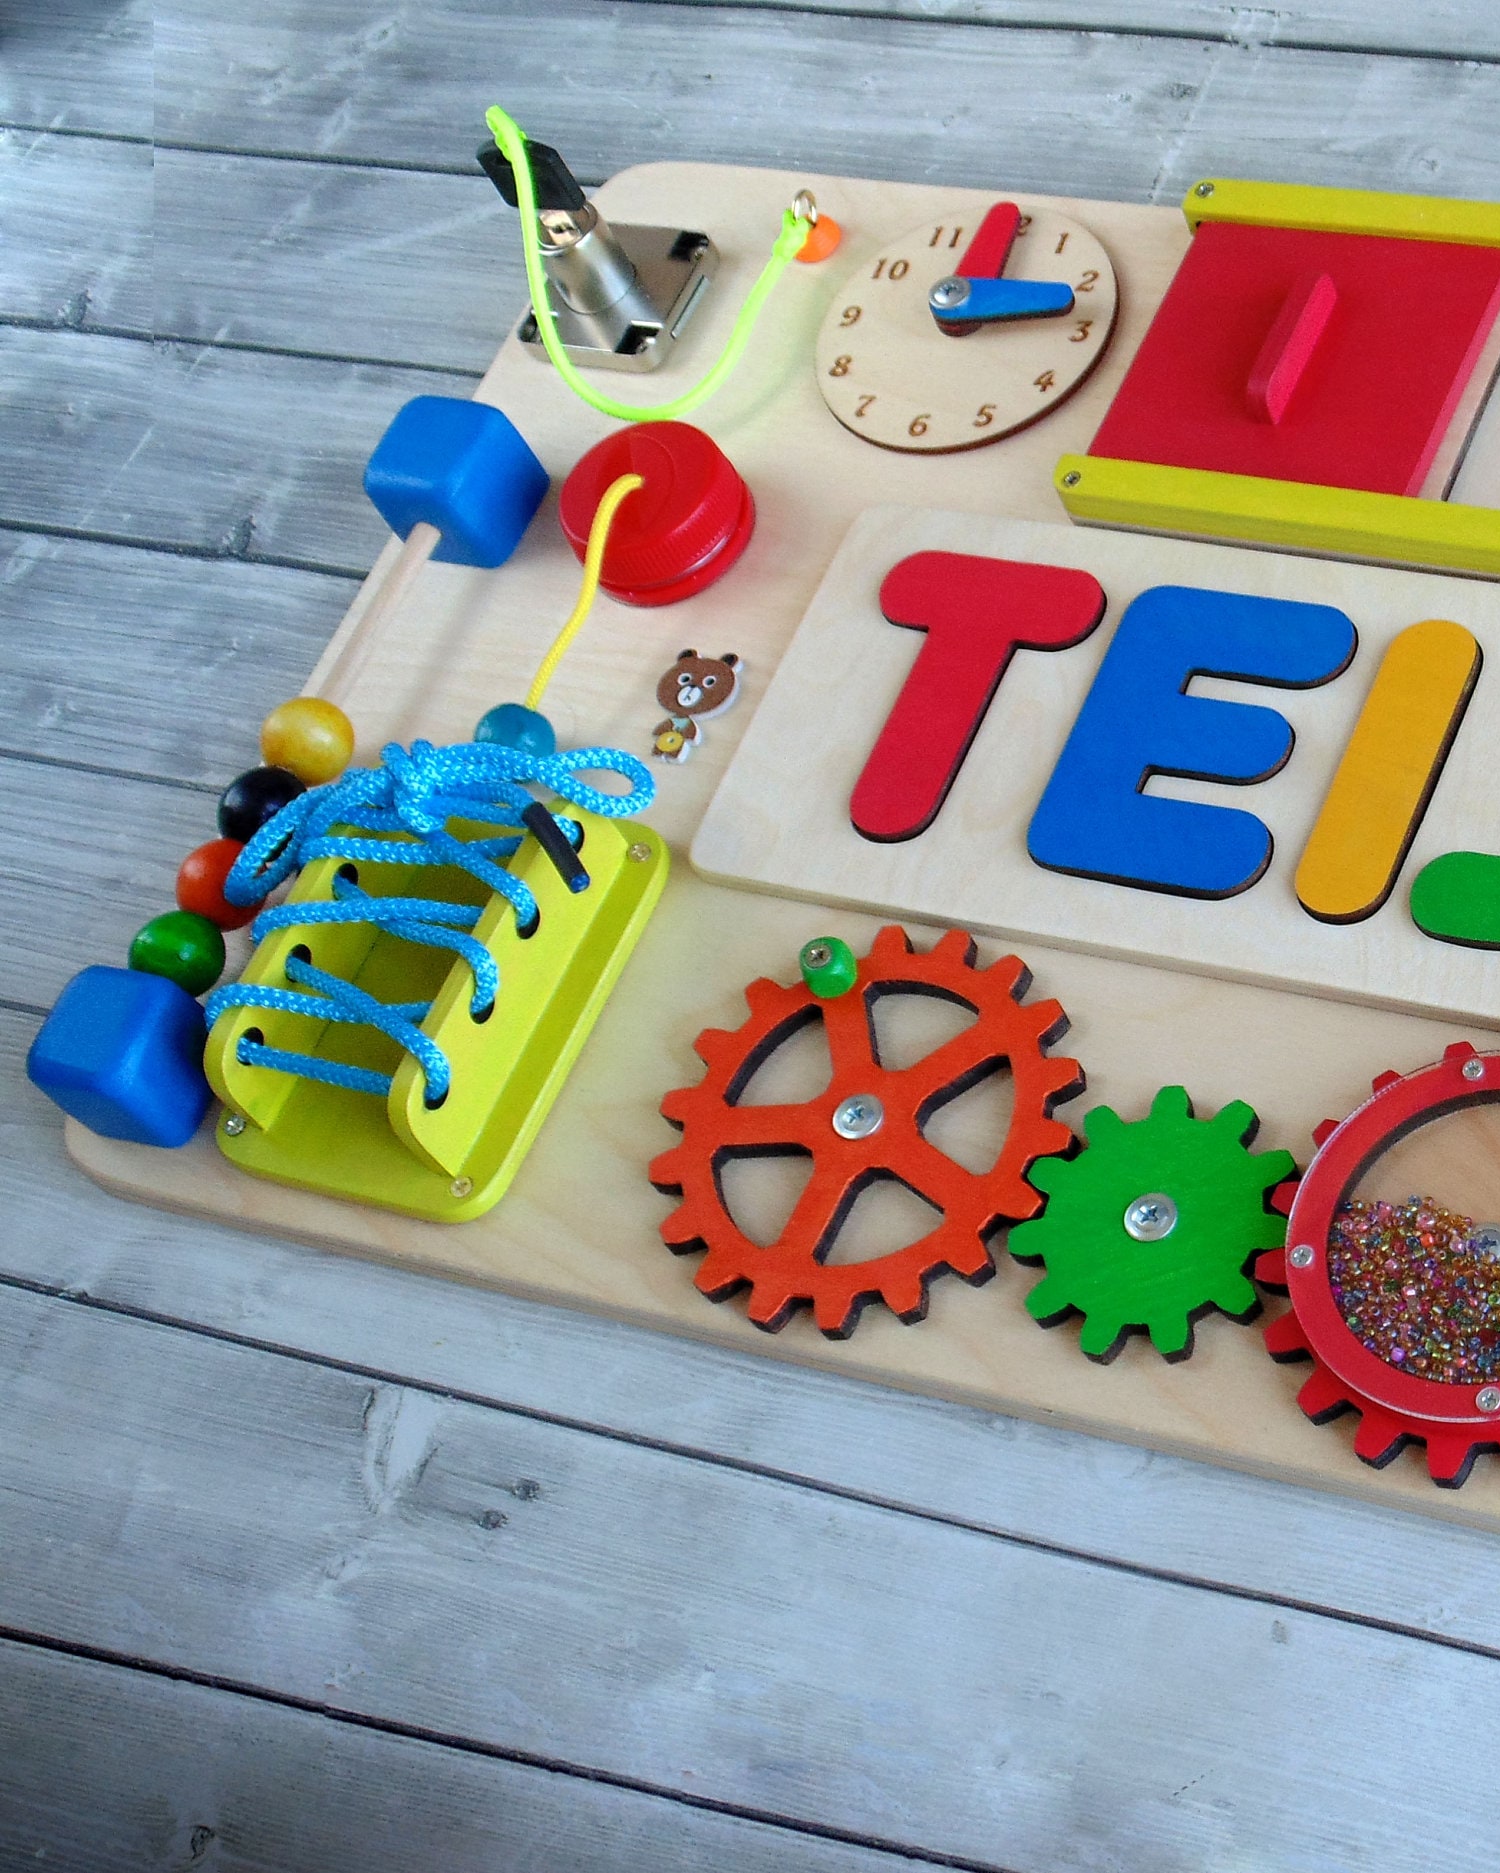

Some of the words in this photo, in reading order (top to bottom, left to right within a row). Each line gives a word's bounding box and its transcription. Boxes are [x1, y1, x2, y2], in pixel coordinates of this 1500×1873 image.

[928, 225, 963, 249] 11
[1054, 232, 1069, 255] 1
[871, 258, 911, 282] 10
[1074, 269, 1100, 293] 2
[838, 305, 863, 329] 9
[1068, 319, 1094, 343] 3
[828, 355, 853, 378] 8
[1032, 369, 1055, 393] 4
[854, 394, 877, 419] 7
[972, 403, 997, 428] 5
[907, 413, 932, 438] 6
